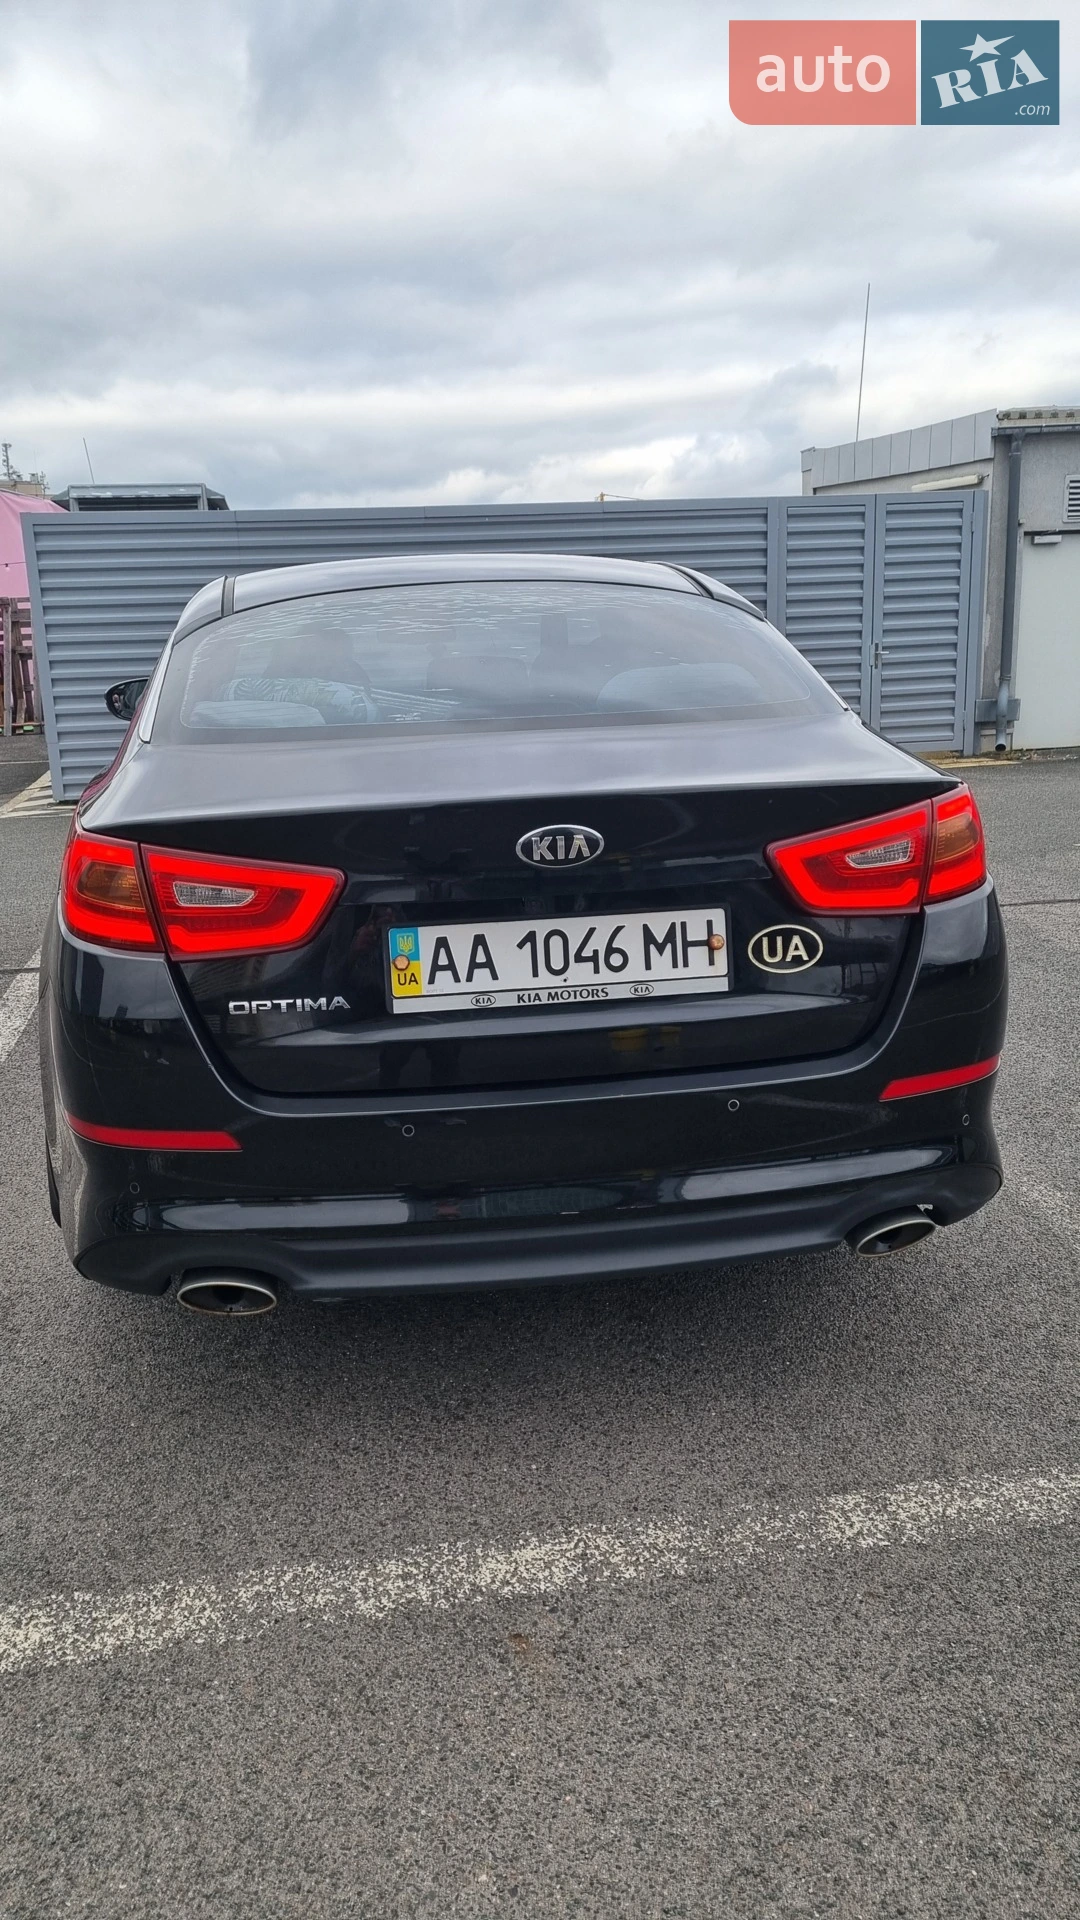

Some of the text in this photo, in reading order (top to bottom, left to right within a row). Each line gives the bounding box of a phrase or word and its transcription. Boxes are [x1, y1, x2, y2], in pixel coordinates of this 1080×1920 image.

[531, 834, 591, 861] KIA
[427, 919, 716, 985] AA 1046 MH
[762, 934, 810, 963] UA
[397, 972, 419, 986] UA
[516, 987, 609, 1004] KIA MOTORS
[632, 986, 651, 995] KIA
[228, 996, 351, 1015] OPTIMA
[475, 997, 493, 1005] KIA
